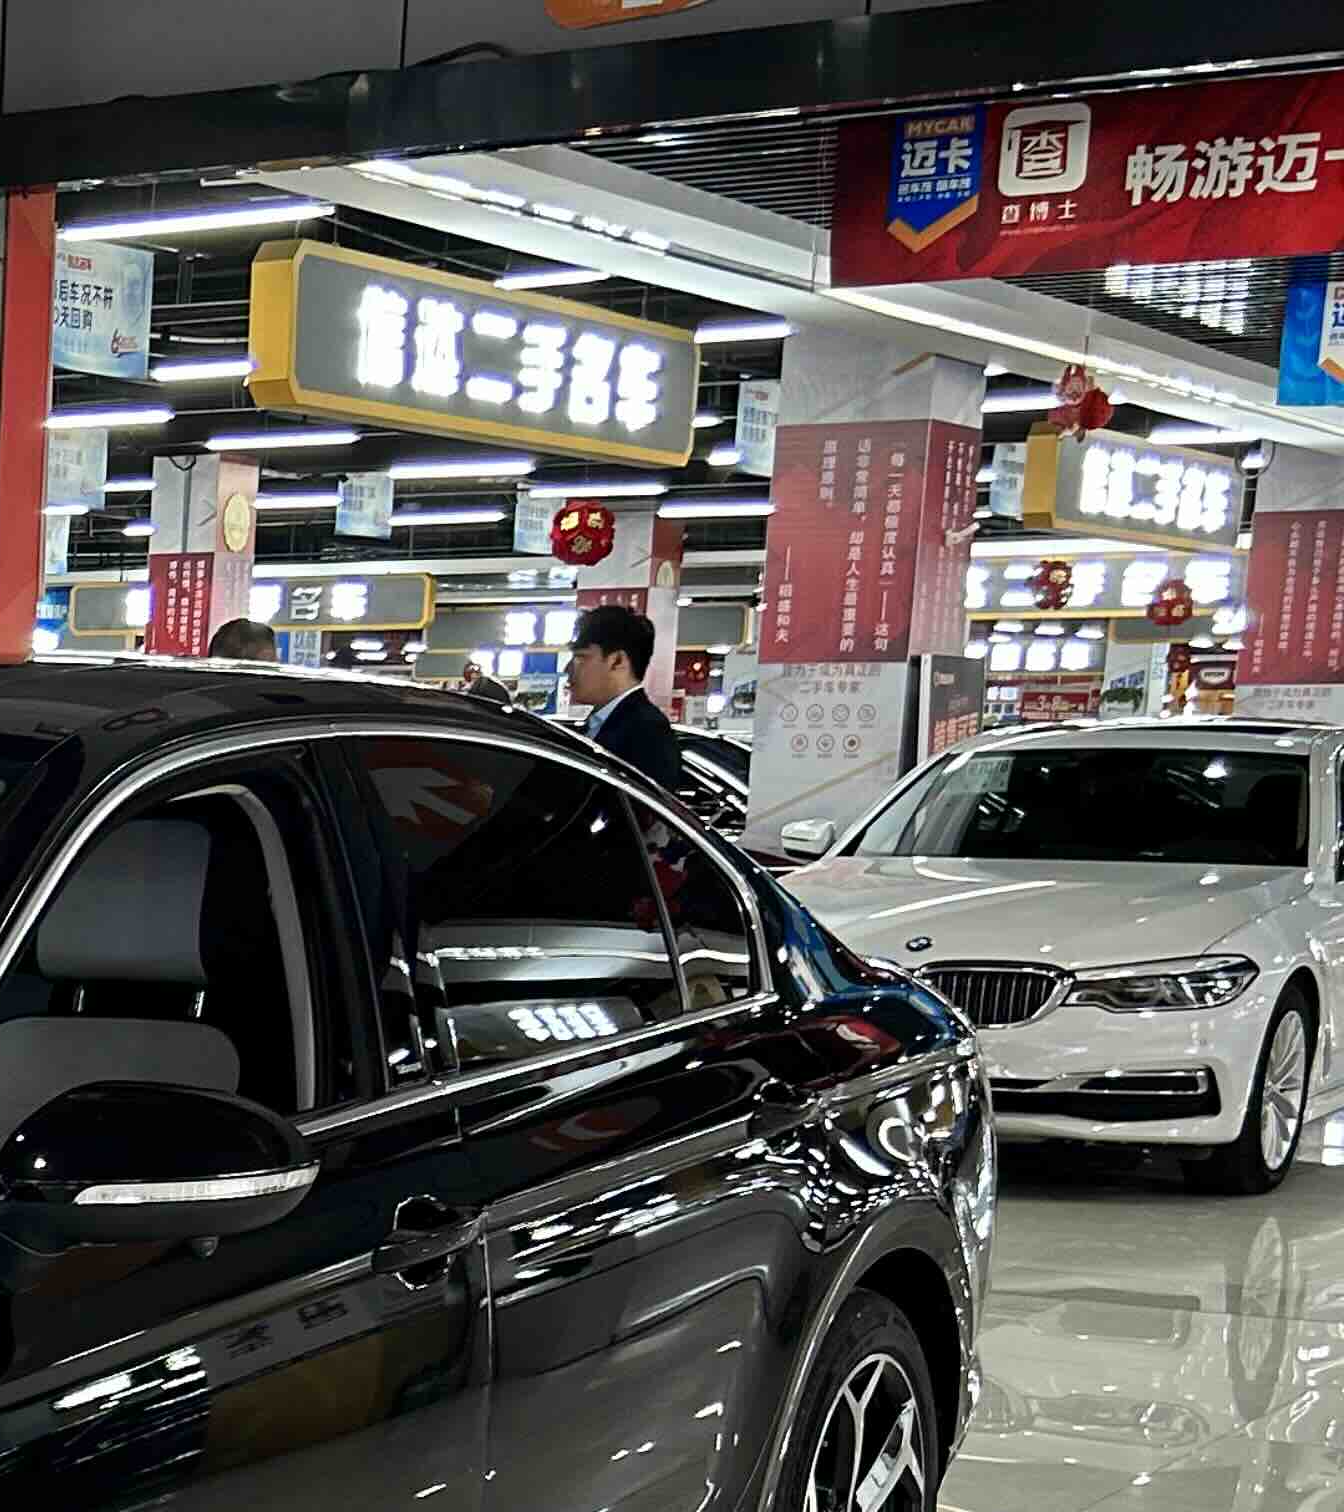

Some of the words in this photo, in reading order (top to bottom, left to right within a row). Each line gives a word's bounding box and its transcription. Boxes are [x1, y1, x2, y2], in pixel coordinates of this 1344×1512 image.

[899, 135, 974, 178] 迈卡
[1124, 131, 1344, 207] 畅游迈
[1001, 199, 1079, 226] 查博士
[54, 279, 114, 310] 后车况不符
